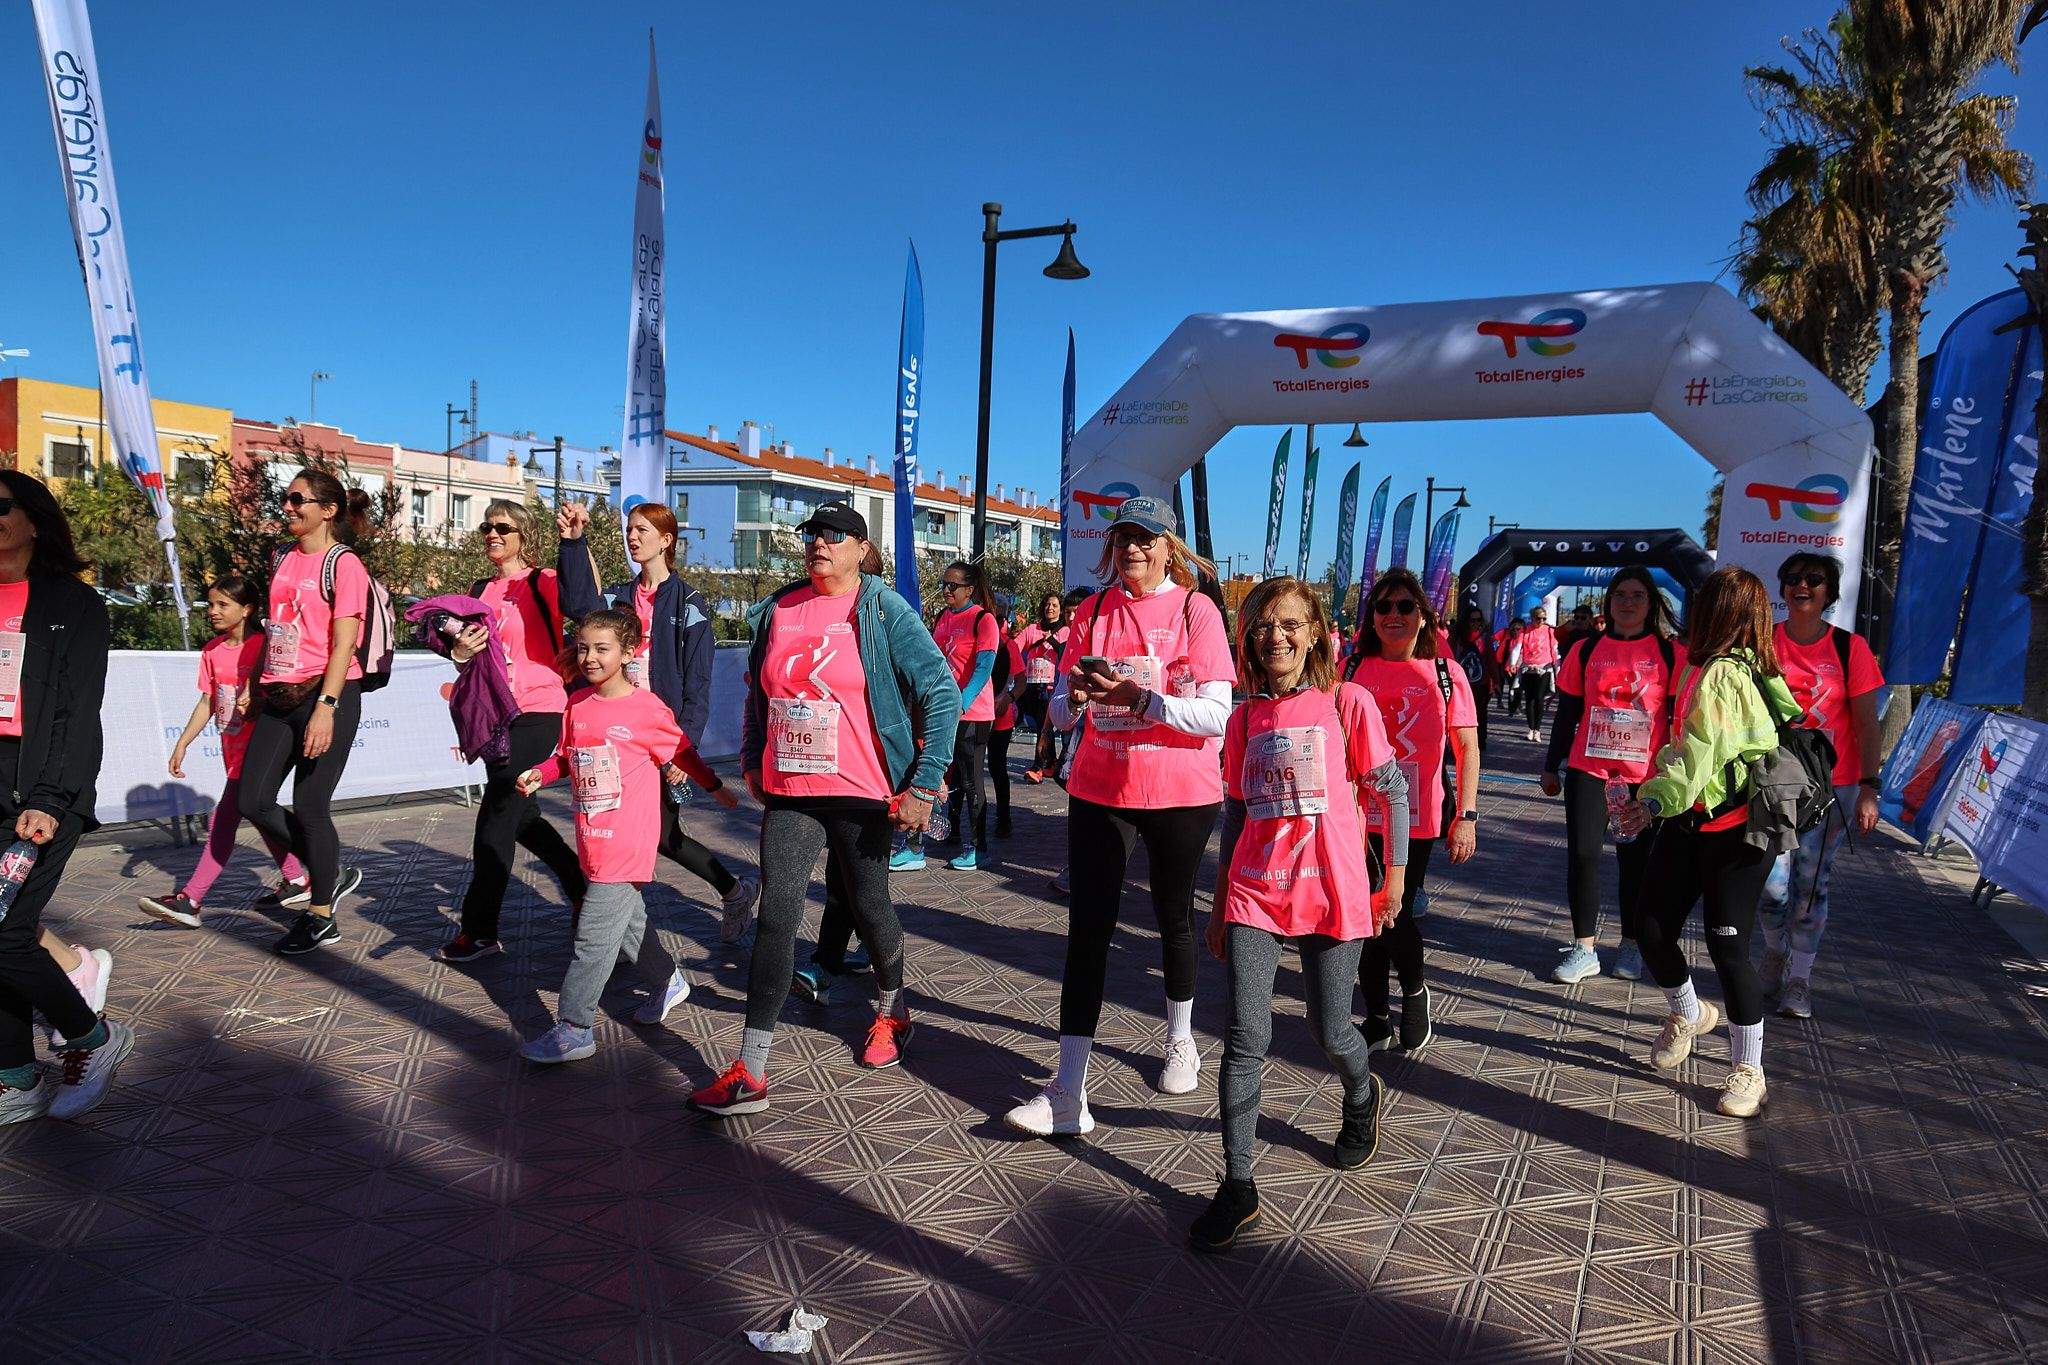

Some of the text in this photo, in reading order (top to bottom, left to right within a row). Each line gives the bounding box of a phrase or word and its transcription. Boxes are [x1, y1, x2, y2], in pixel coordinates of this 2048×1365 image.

[1475, 366, 1585, 384] TotalEnergies
[1273, 378, 1370, 394] TotalEnergies
[1910, 397, 1983, 543] Marlene
[1070, 529, 1108, 539] TotalEne
[1740, 531, 1844, 548] TotalEnergies
[1529, 541, 1650, 552] VOLVO
[356, 717, 390, 730] ocina
[786, 731, 813, 745] 016
[1609, 730, 1632, 741] 016
[1264, 767, 1295, 784] 016
[1275, 869, 1288, 880] DE
